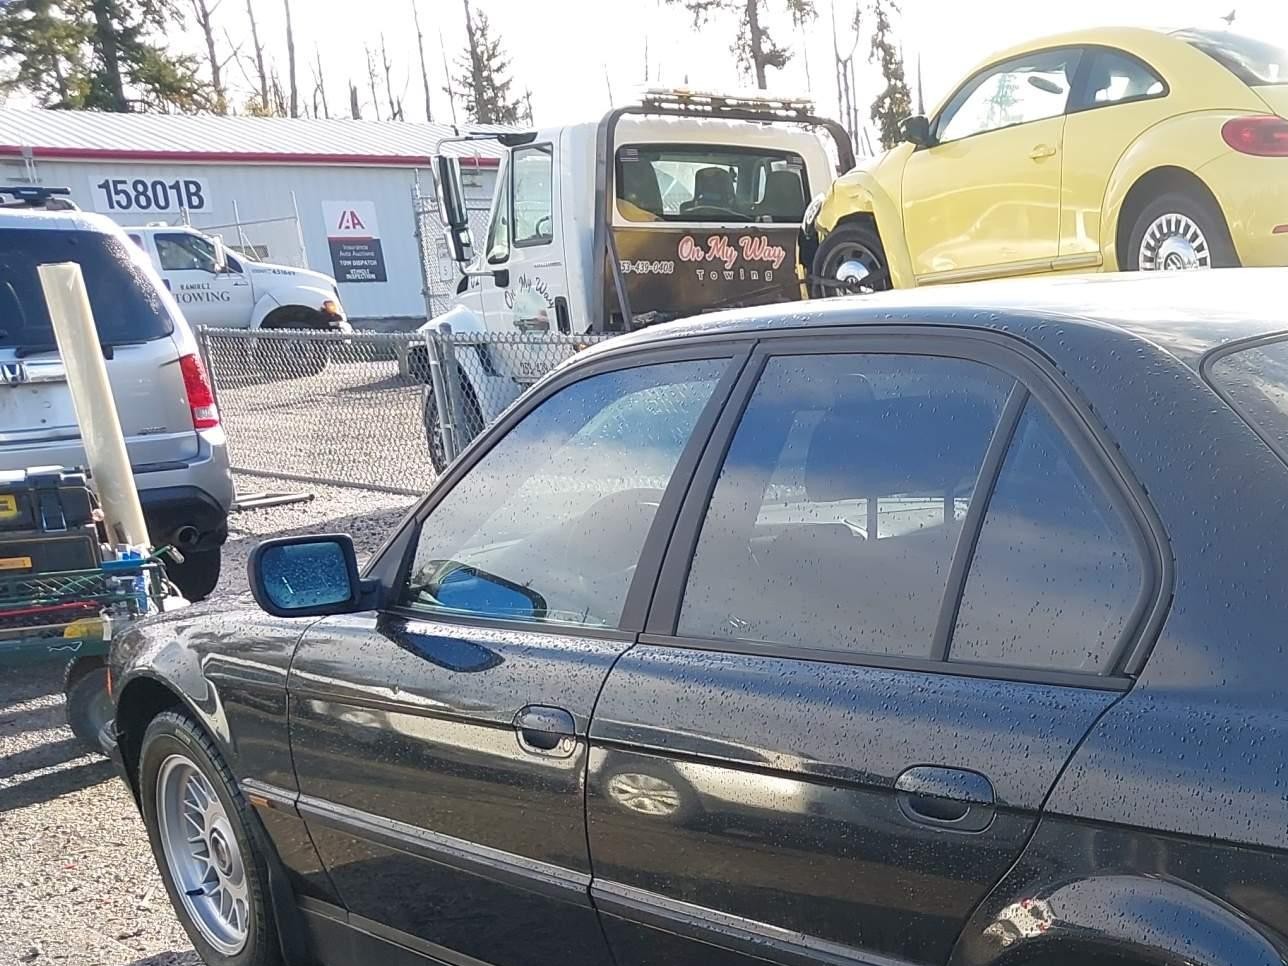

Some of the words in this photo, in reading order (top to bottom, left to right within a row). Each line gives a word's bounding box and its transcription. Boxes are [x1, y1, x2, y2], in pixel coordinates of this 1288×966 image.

[97, 179, 205, 210] 15801B
[678, 236, 704, 261] On
[706, 235, 738, 270] My
[738, 236, 786, 270] Way
[696, 269, 774, 282] Towing
[175, 290, 231, 304] TOWING
